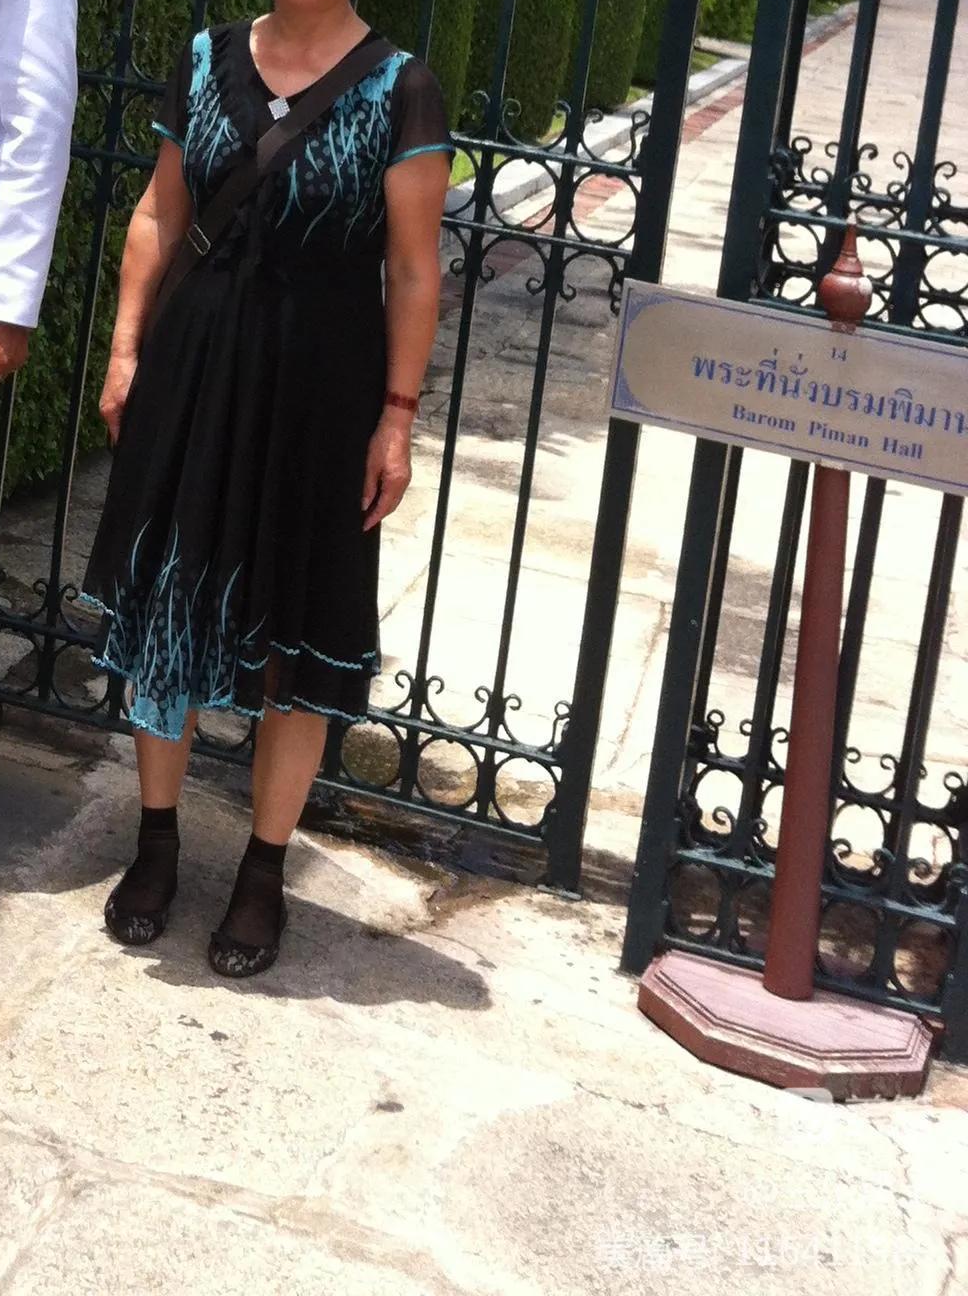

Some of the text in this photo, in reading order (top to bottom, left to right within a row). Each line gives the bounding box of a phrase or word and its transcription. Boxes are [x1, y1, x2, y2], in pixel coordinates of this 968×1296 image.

[731, 403, 924, 460] Barom Piman Hall
